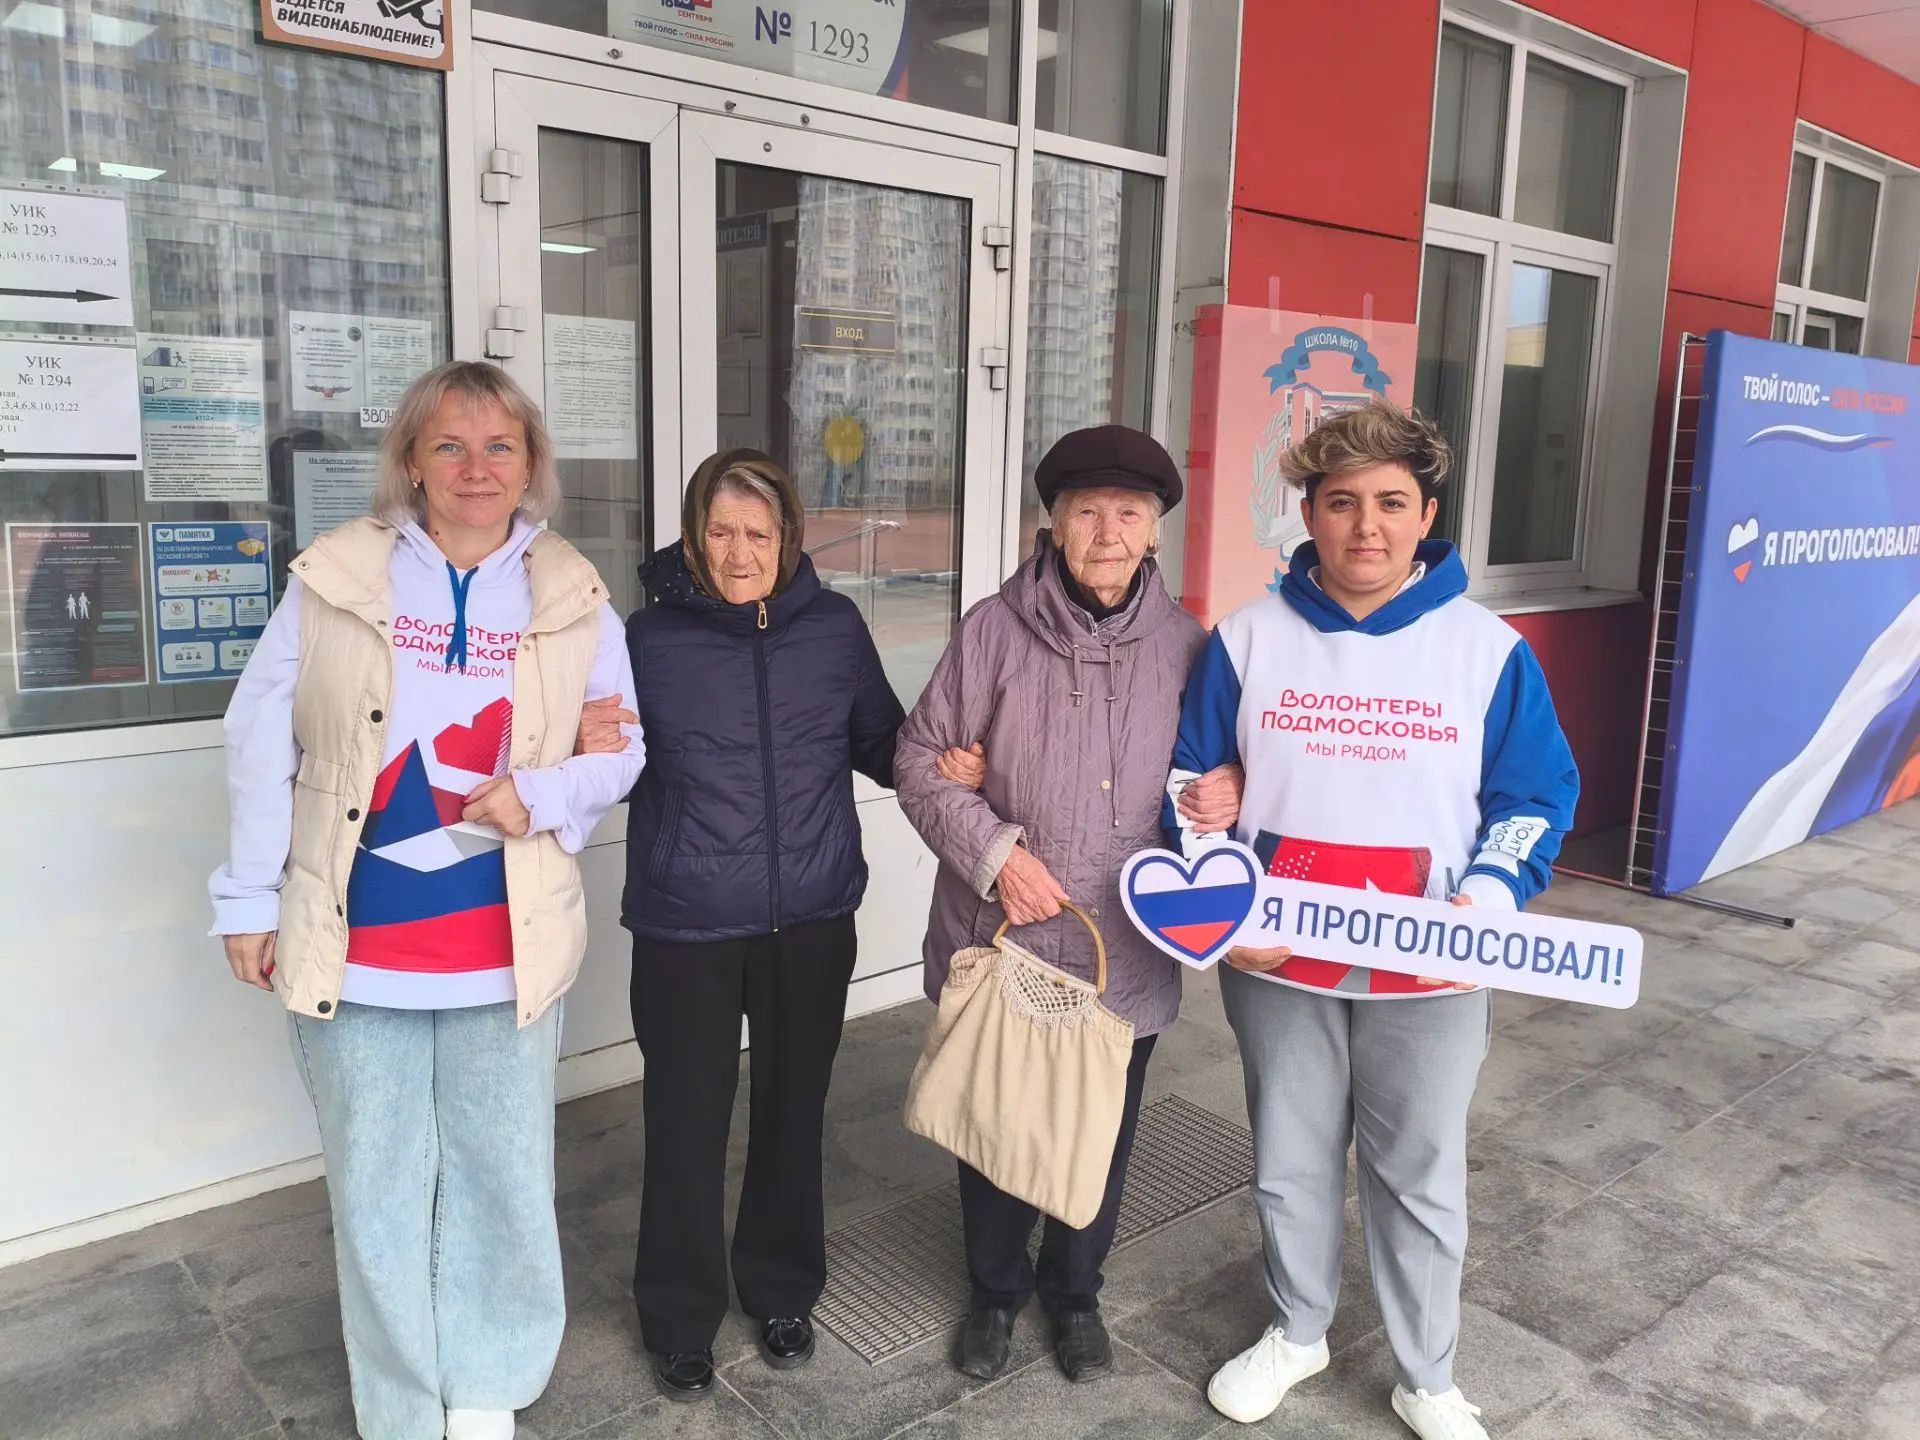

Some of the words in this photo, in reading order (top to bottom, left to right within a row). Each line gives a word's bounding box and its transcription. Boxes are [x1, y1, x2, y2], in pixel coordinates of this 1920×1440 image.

[276, 0, 345, 14] ДЕТСЯ
[677, 10, 713, 23] СЕНТЯБРЯ
[277, 8, 435, 48] ВИДЕОНАБЛЮДЕНИЕ!
[634, 20, 653, 30] ТВОЙ
[654, 24, 678, 36] ГОЛОС
[684, 31, 704, 42] СИЛА
[755, 6, 792, 44] №
[809, 20, 869, 63] 1293
[10, 203, 47, 219] УИК
[2, 221, 19, 234] №
[25, 223, 57, 238] 1293
[0, 250, 118, 268] ,14,15,16,17,18,19,20,24
[835, 326, 864, 341] ВХОД
[1304, 332, 1338, 349] ШКОЛА
[25, 355, 62, 369] УИК
[18, 373, 34, 386] №
[40, 374, 72, 388] 1294
[1743, 372, 1778, 400] ТВОЙ
[1779, 380, 1821, 407] ГОЛОС
[178, 530, 212, 539] ПАМЯТКА
[1762, 531, 1778, 567] Я
[1780, 525, 1920, 566] ПРОГОЛОСОВАЛ!
[392, 634, 517, 661] ОДМСКОВ
[416, 658, 444, 674] МЫ
[1279, 688, 1442, 719] ВОЛОНТЕРЫ
[1261, 711, 1459, 744] ПОДМОСКОВЬЯ
[1305, 741, 1337, 757] МЫ
[1341, 744, 1407, 762] РЯДОМ
[1260, 896, 1283, 932] Я
[1296, 901, 1624, 986] ПРОГОЛОСОВАЛ!
